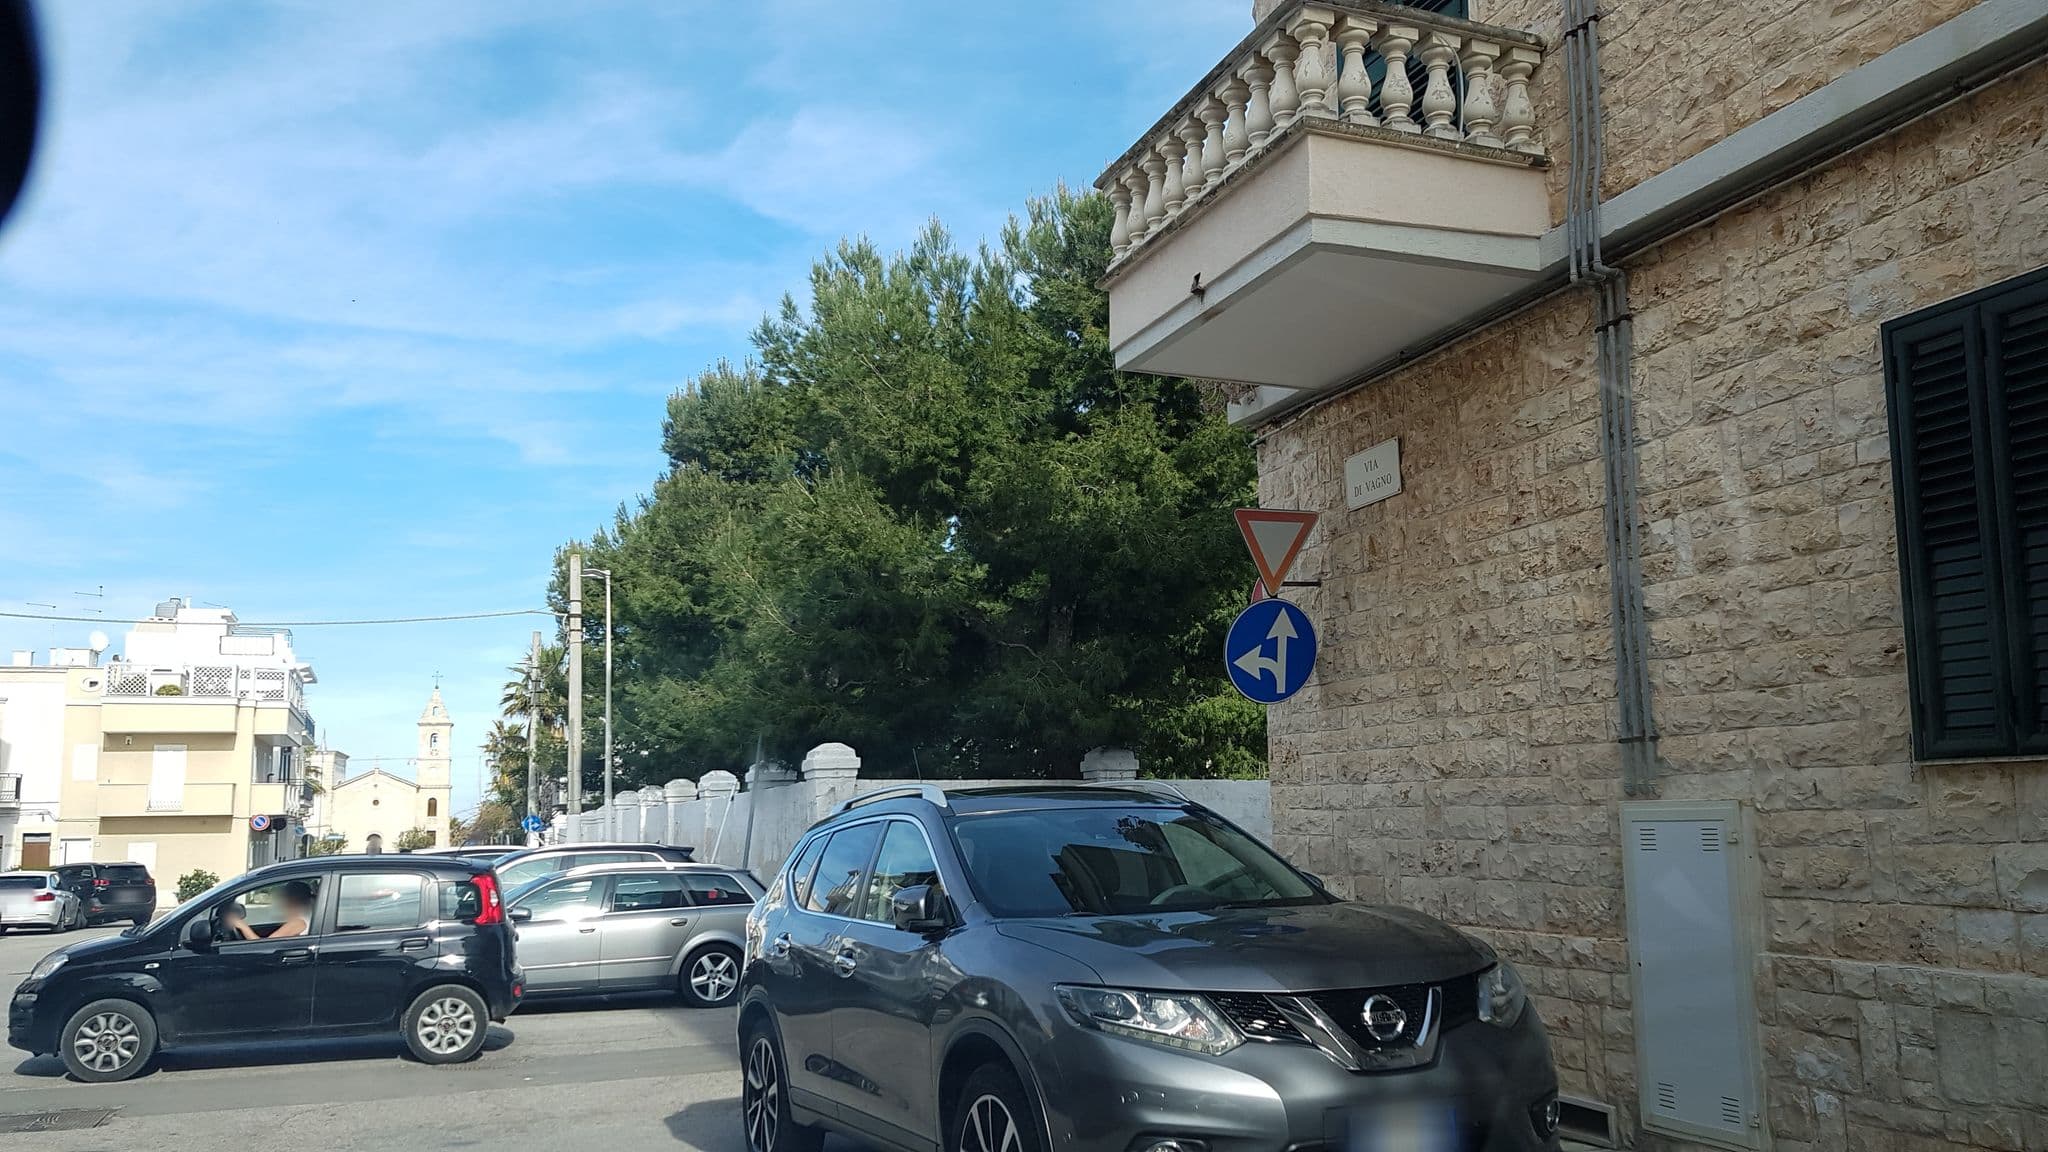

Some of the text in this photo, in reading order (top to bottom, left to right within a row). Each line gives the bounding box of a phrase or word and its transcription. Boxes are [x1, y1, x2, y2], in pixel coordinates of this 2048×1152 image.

[1364, 459, 1378, 472] VIA
[1354, 473, 1392, 497] DI VAGNO
